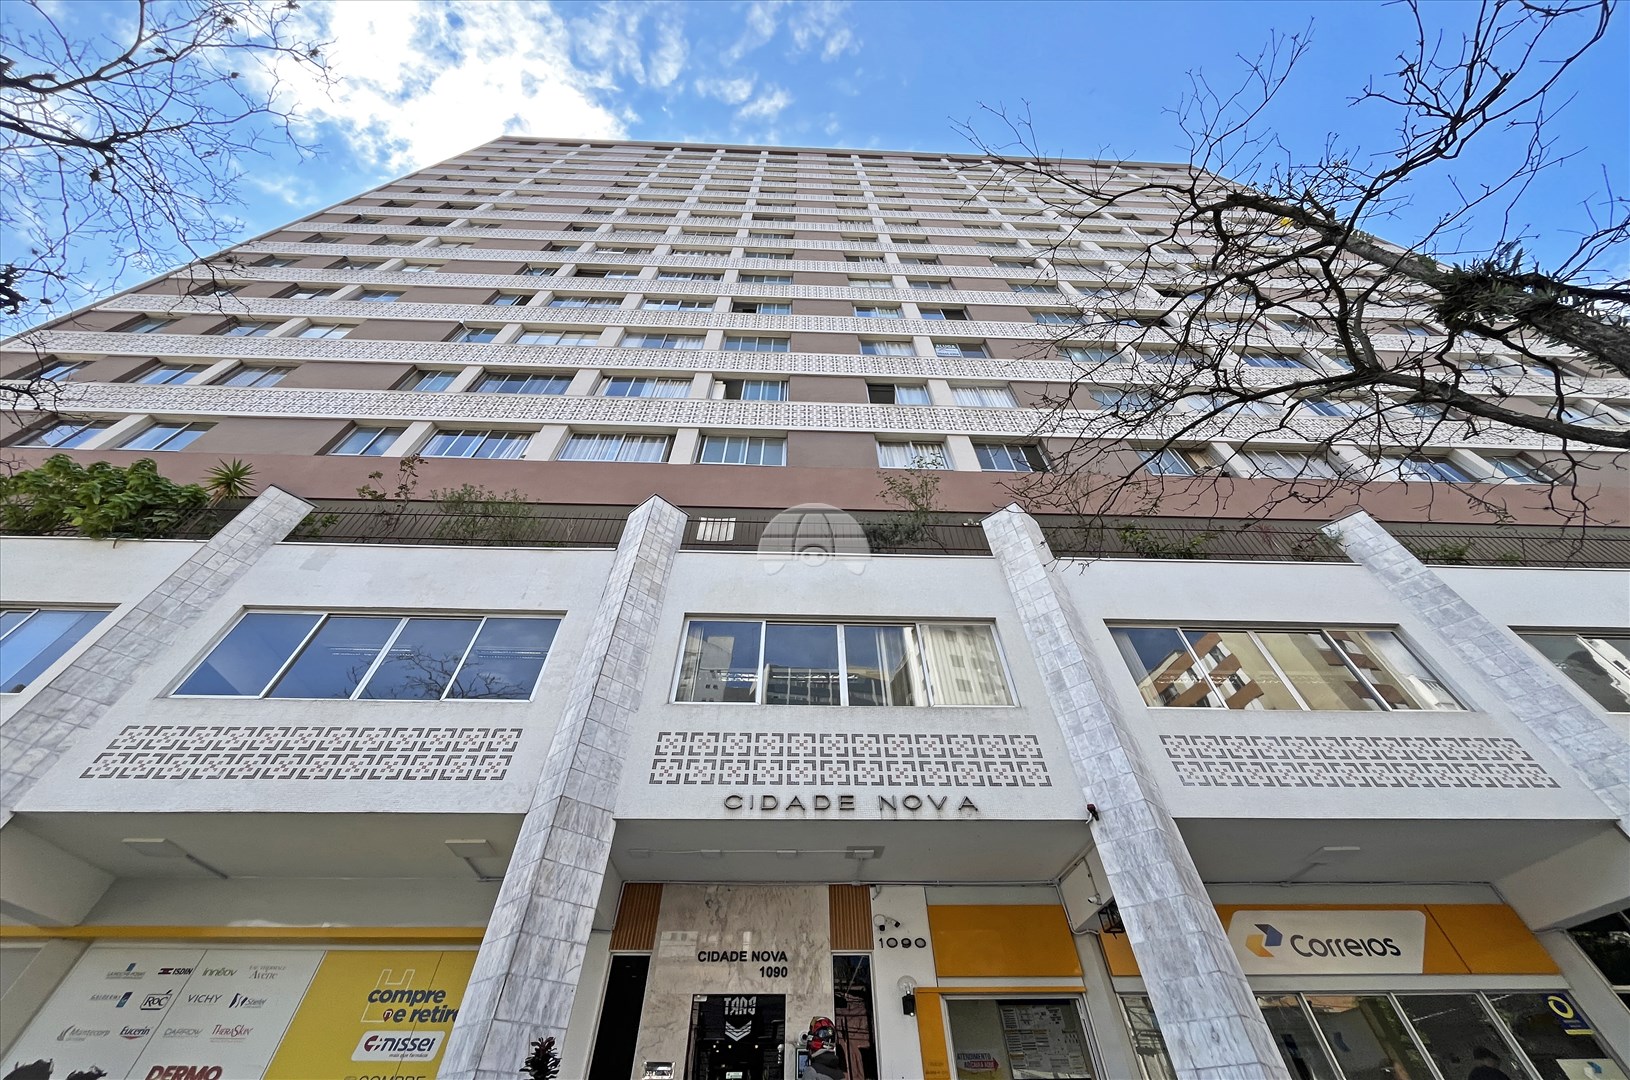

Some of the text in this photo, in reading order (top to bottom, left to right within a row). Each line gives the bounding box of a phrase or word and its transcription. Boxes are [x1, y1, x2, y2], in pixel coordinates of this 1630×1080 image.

[724, 795, 979, 811] CIDADE NOVA
[879, 937, 926, 948] 1090
[1290, 934, 1401, 957] Correios
[697, 951, 788, 962] CIDADE NOVA
[759, 966, 788, 978] 1090
[188, 994, 223, 1003] VICHY
[367, 989, 446, 1006] compre
[393, 1008, 406, 1022] e
[120, 1025, 151, 1035] Eucerin
[380, 1038, 436, 1052] nissei
[145, 1065, 223, 1080] DERMO
